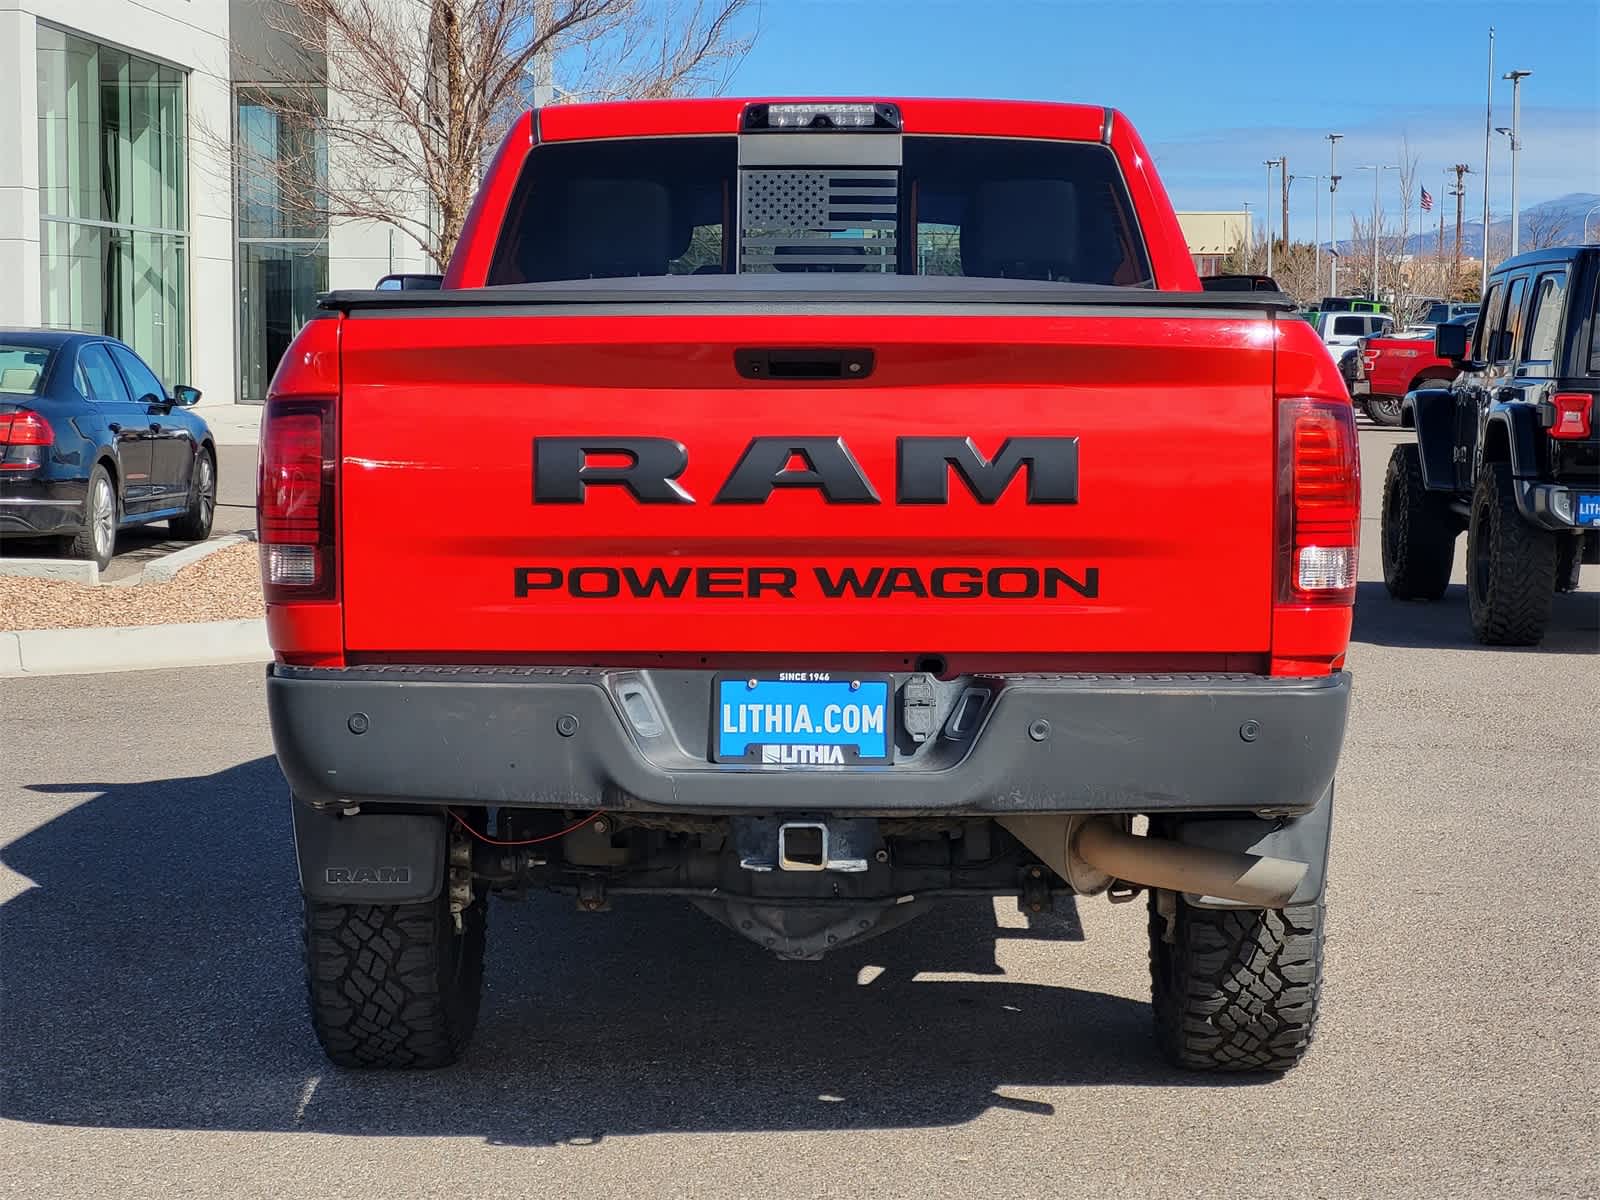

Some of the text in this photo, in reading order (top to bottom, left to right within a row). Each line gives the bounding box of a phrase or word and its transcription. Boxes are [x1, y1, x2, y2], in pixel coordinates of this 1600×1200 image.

[532, 435, 1080, 505] RAM
[513, 567, 1100, 599] POWER WAGON
[779, 672, 830, 681] SINCE 1946
[723, 704, 884, 733] LITHIA.COM
[780, 745, 845, 764] LITHIA
[326, 867, 411, 883] RAM
